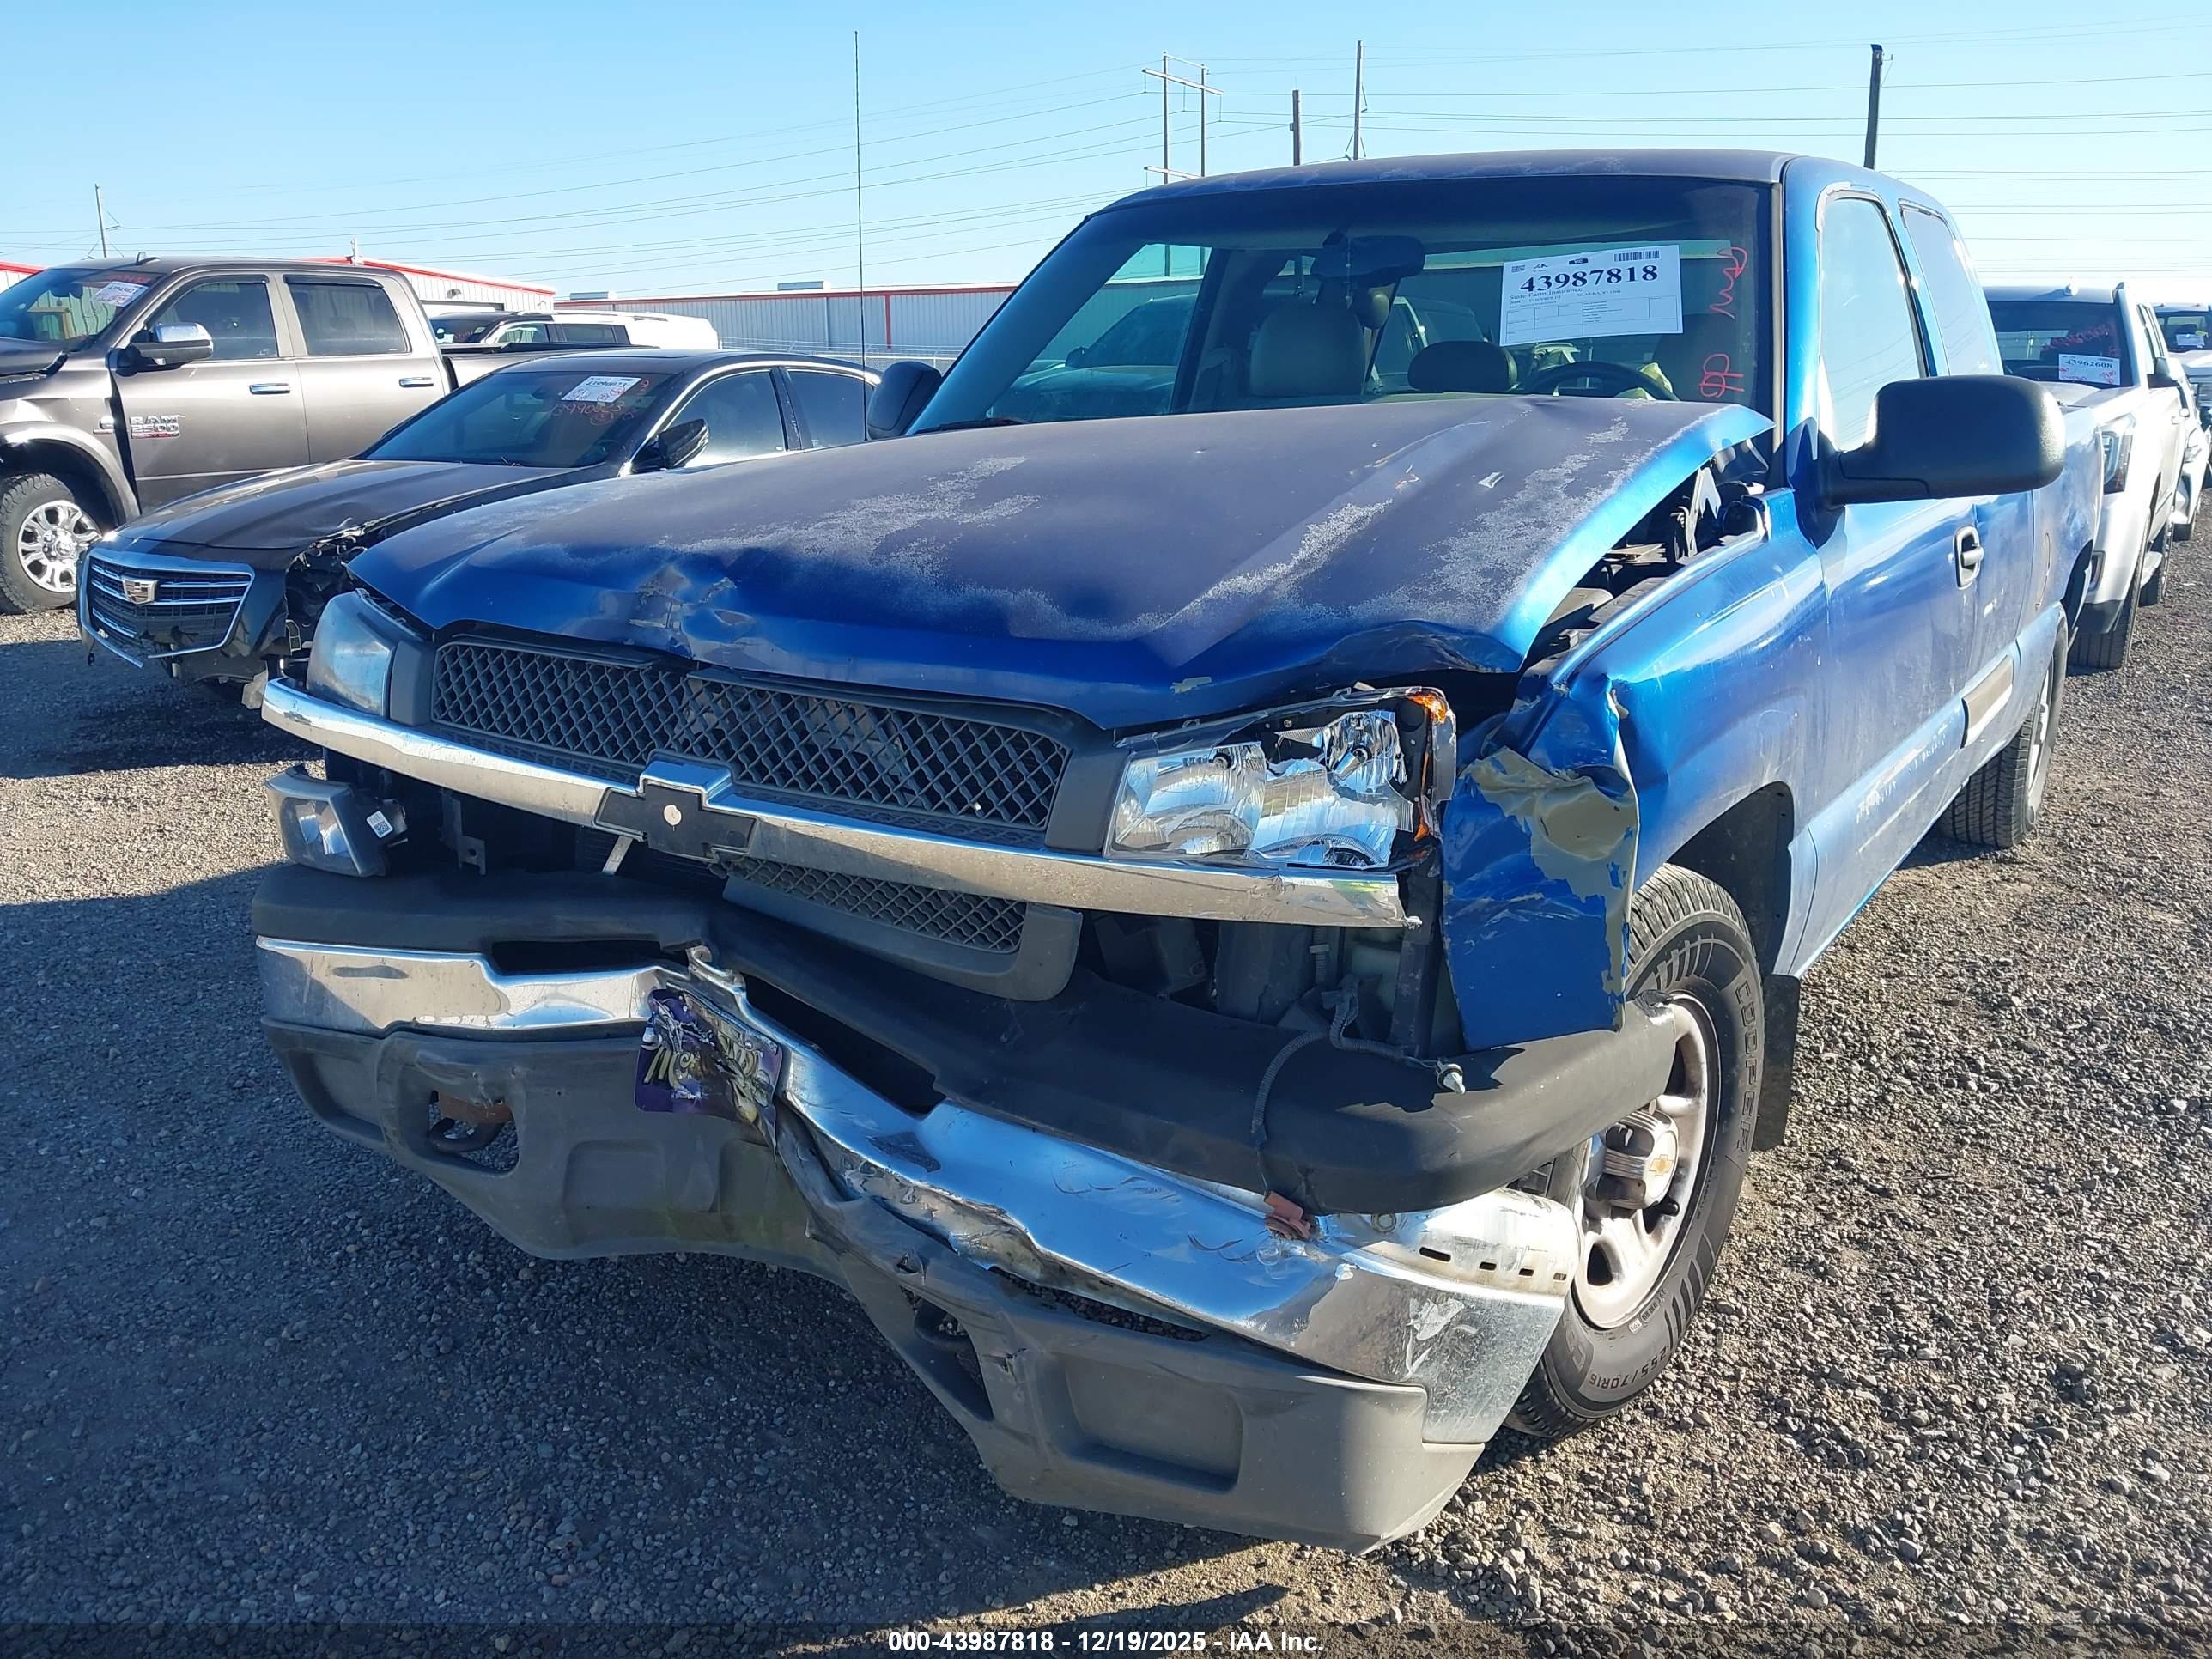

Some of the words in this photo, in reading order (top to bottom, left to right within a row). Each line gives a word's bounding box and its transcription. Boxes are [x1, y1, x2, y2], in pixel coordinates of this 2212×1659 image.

[1520, 265, 1658, 292] 43987818
[1548, 288, 1583, 296] Insurance
[129, 415, 179, 424] RAM
[131, 423, 179, 433] 2500
[1735, 981, 1758, 1152] COOPER
[1589, 1346, 1667, 1389] 255/70R16
